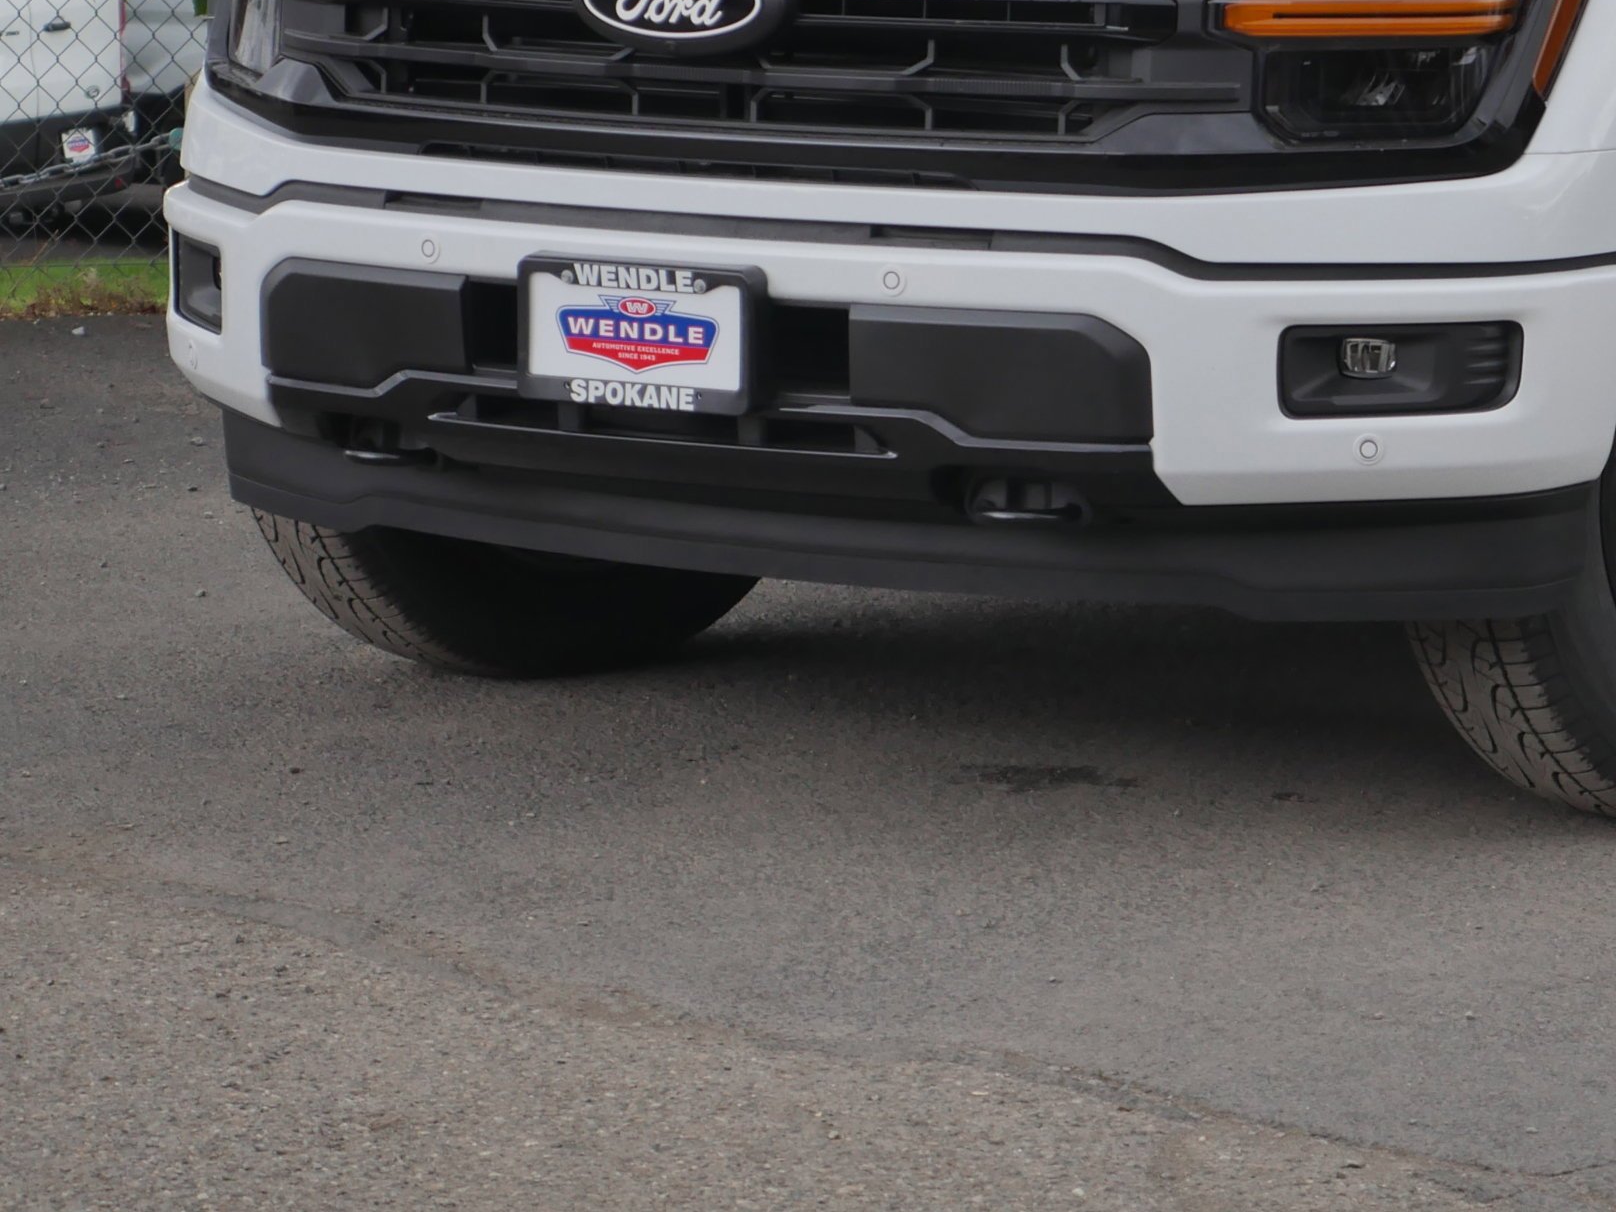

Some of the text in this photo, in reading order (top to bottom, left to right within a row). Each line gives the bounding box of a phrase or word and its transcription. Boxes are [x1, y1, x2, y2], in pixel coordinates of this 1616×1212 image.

[573, 262, 694, 293] WENDLE
[567, 316, 704, 345] WENDLE
[592, 341, 680, 356] AUTOMOTIVE EXCELLENCE
[618, 352, 656, 363] SINCE 1943
[570, 378, 694, 412] SPOKANE
